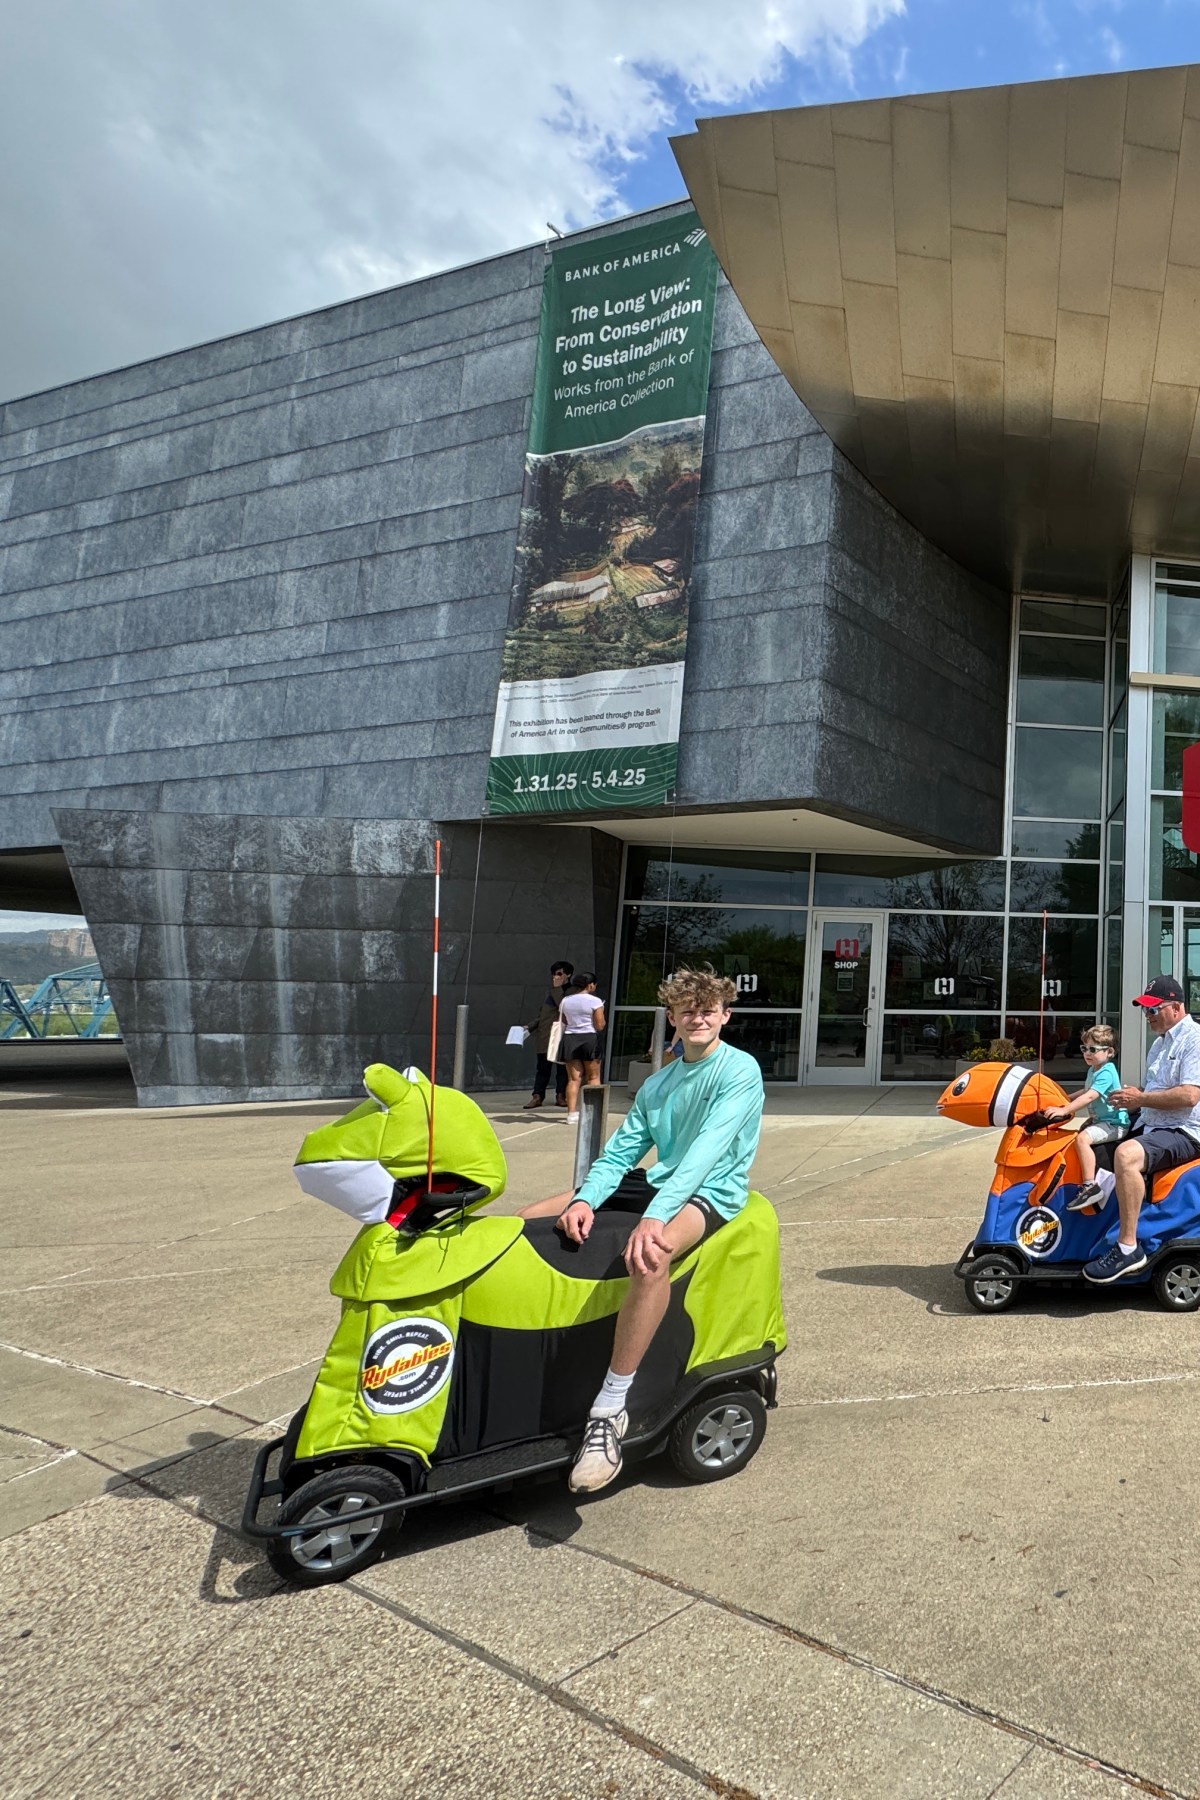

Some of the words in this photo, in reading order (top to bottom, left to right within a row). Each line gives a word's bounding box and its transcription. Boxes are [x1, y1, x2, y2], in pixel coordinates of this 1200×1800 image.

[565, 264, 600, 282] BANK
[603, 259, 620, 273] OF
[623, 242, 681, 268] AMERICA
[571, 304, 599, 324] The
[604, 293, 646, 316] Long
[650, 277, 691, 305] View:
[555, 330, 594, 353] From
[599, 299, 702, 342] Conservation
[562, 359, 577, 376] to
[581, 326, 688, 371] Sustainability
[554, 382, 591, 401] Works
[594, 374, 624, 392] from
[627, 369, 646, 385] the
[648, 356, 676, 377] Bank
[679, 349, 695, 364] of
[564, 399, 616, 419] America
[620, 376, 675, 407] Collection
[509, 720, 522, 728] This
[523, 719, 554, 727] exhibition
[605, 710, 632, 720] through
[633, 709, 645, 717] the
[645, 707, 661, 716] Bank
[510, 730, 518, 738] of
[518, 729, 546, 738] America
[546, 728, 557, 736] Art
[513, 772, 578, 793] 1.31.25
[591, 768, 646, 788] 5.4.25
[834, 961, 859, 969] SHOP
[362, 1340, 453, 1389] Rydables
[372, 1345, 387, 1360] RIDE.
[405, 1331, 430, 1340] REPEAT.
[398, 1371, 417, 1381] .com
